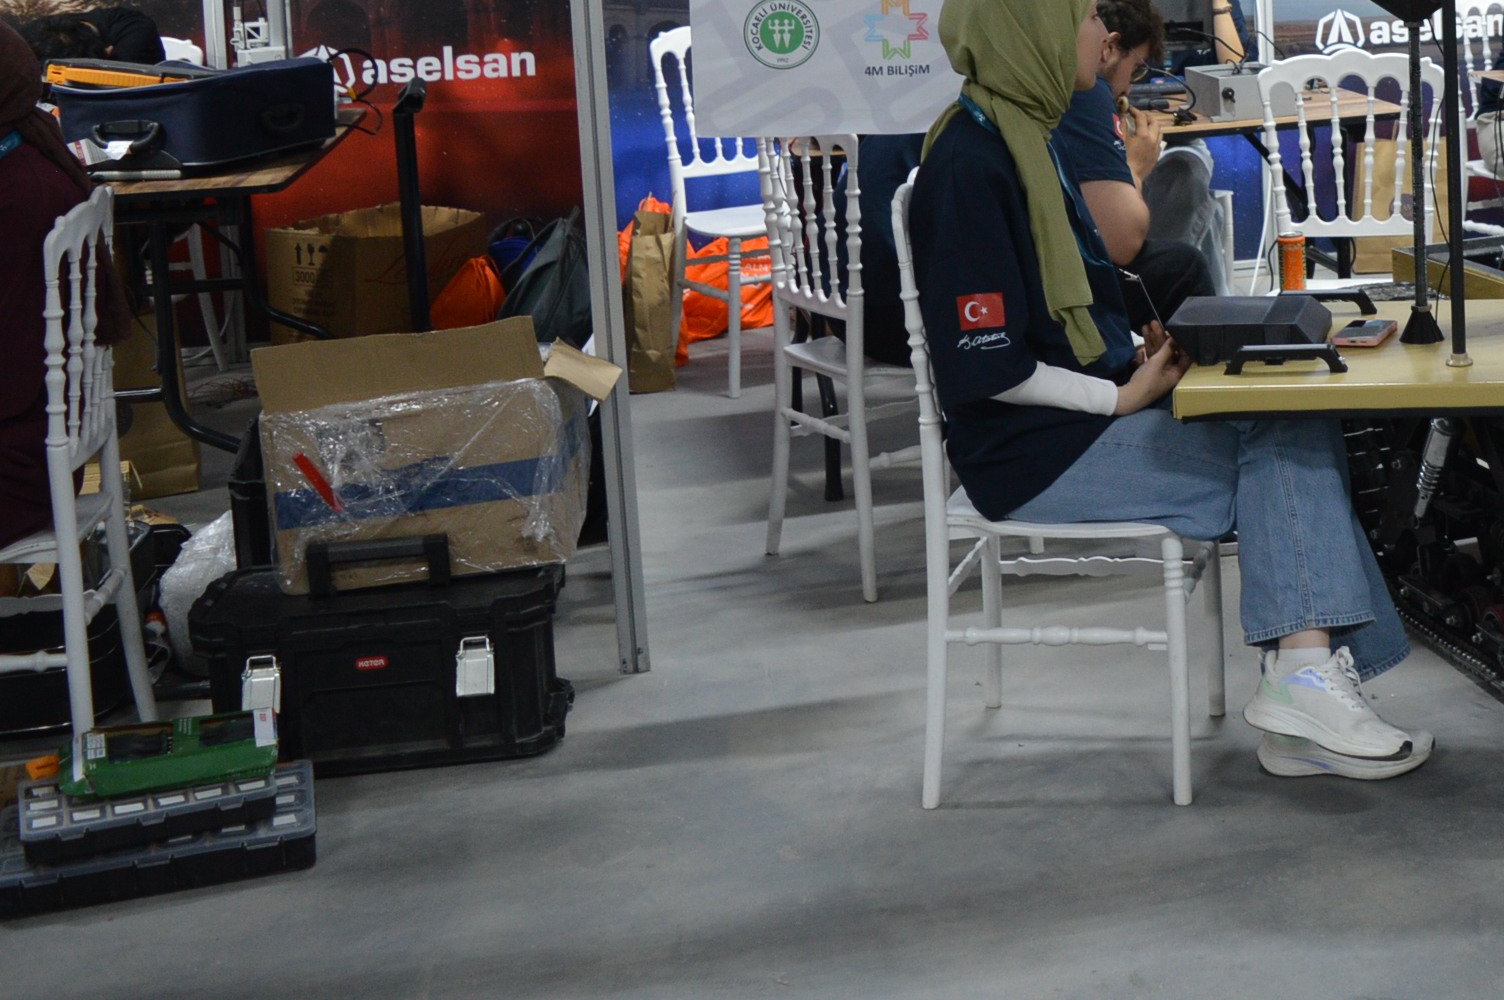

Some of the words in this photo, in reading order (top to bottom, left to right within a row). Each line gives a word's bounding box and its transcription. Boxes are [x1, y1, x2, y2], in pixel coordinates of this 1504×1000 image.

[361, 45, 537, 86] aselsan
[864, 65, 884, 77] 4M
[358, 658, 386, 668] KETER
